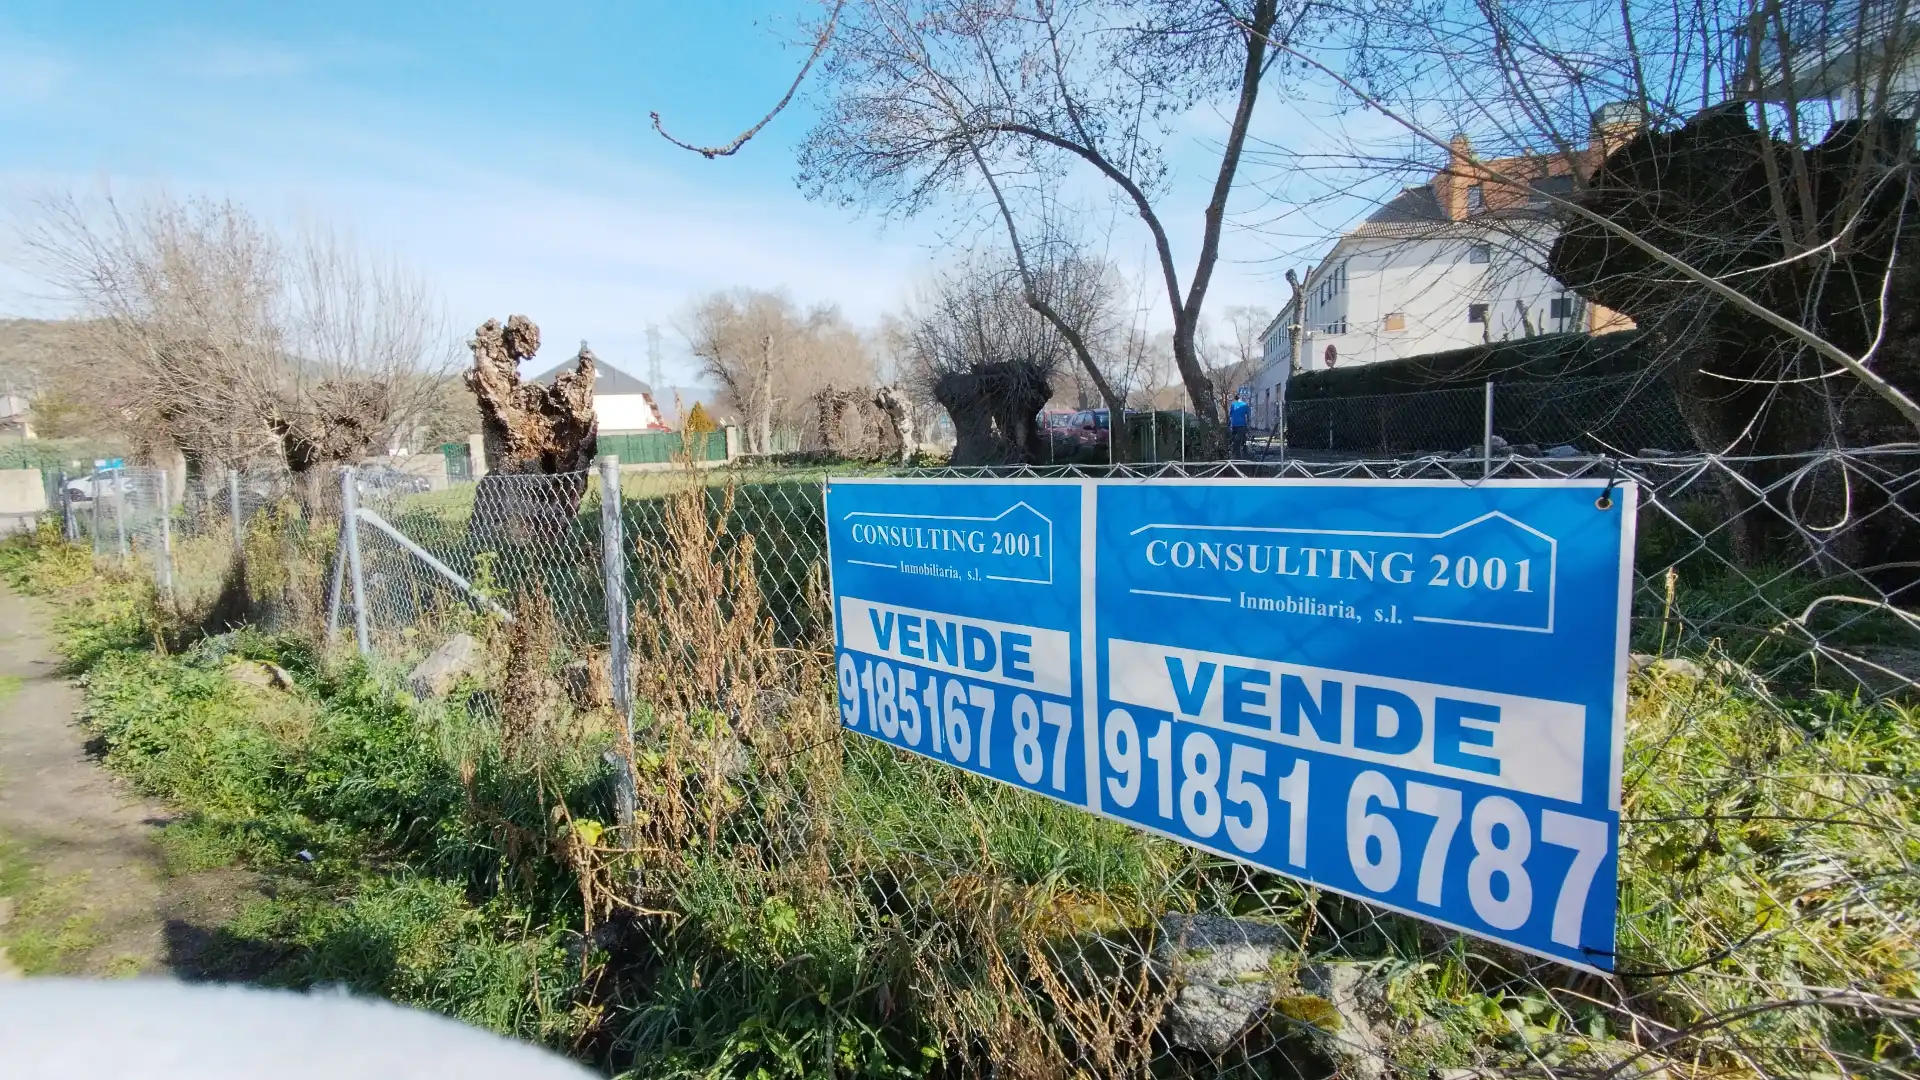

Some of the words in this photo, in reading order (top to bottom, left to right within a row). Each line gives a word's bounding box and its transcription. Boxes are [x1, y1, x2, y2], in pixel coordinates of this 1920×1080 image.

[852, 523, 986, 553] CONSULTING
[992, 532, 1043, 558] 2001
[900, 560, 962, 581] Inmobiliaria,
[967, 567, 982, 581] s.l.
[1145, 538, 1415, 585] CONSULTING
[1428, 554, 1534, 593] 2001
[1239, 591, 1362, 624] Inmobiliaria,
[1374, 604, 1403, 625] s.l.
[869, 607, 1035, 683] VENDE
[1164, 655, 1502, 777] VENDE
